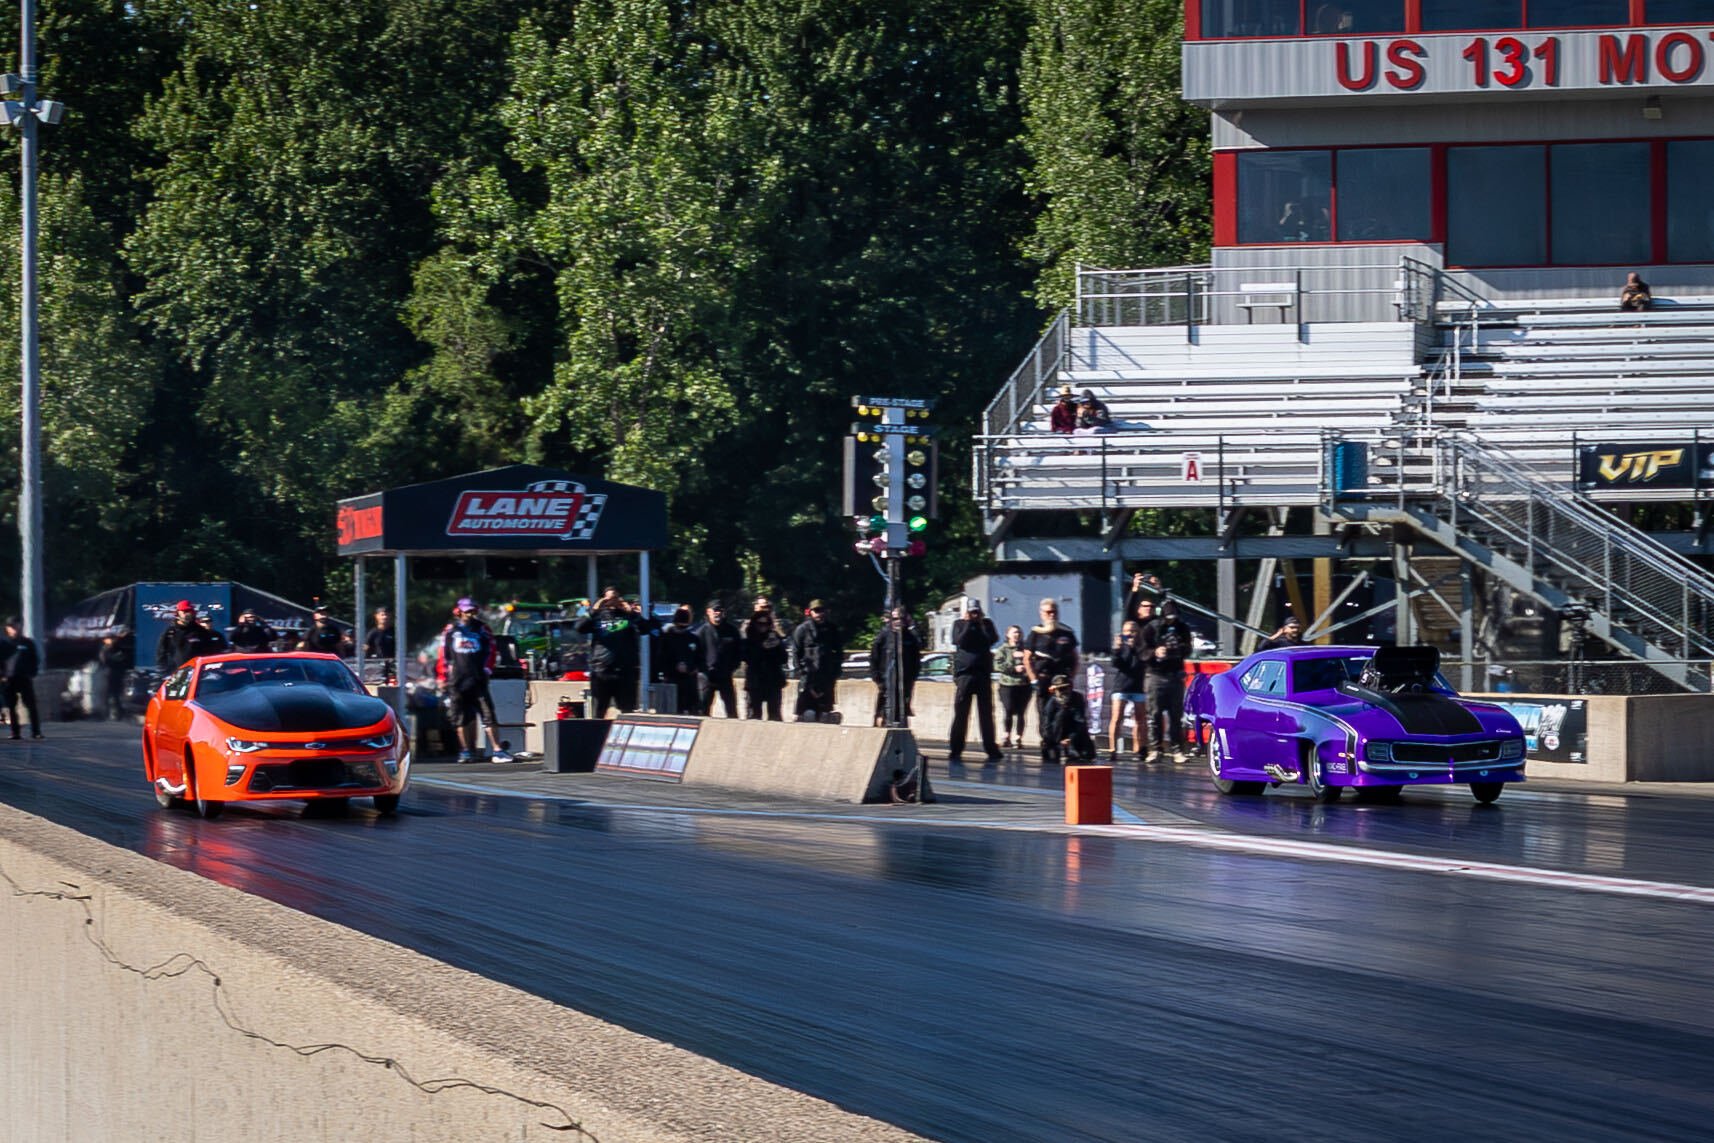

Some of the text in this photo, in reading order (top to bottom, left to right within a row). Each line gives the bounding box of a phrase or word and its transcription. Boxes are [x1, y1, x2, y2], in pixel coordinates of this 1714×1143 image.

[1336, 32, 1714, 91] US 131 MO
[873, 424, 919, 434] STAGE
[1186, 460, 1199, 481] A
[1598, 448, 1685, 482] VIP
[465, 498, 574, 516] LANE
[457, 518, 567, 529] AUTOMOTIVE
